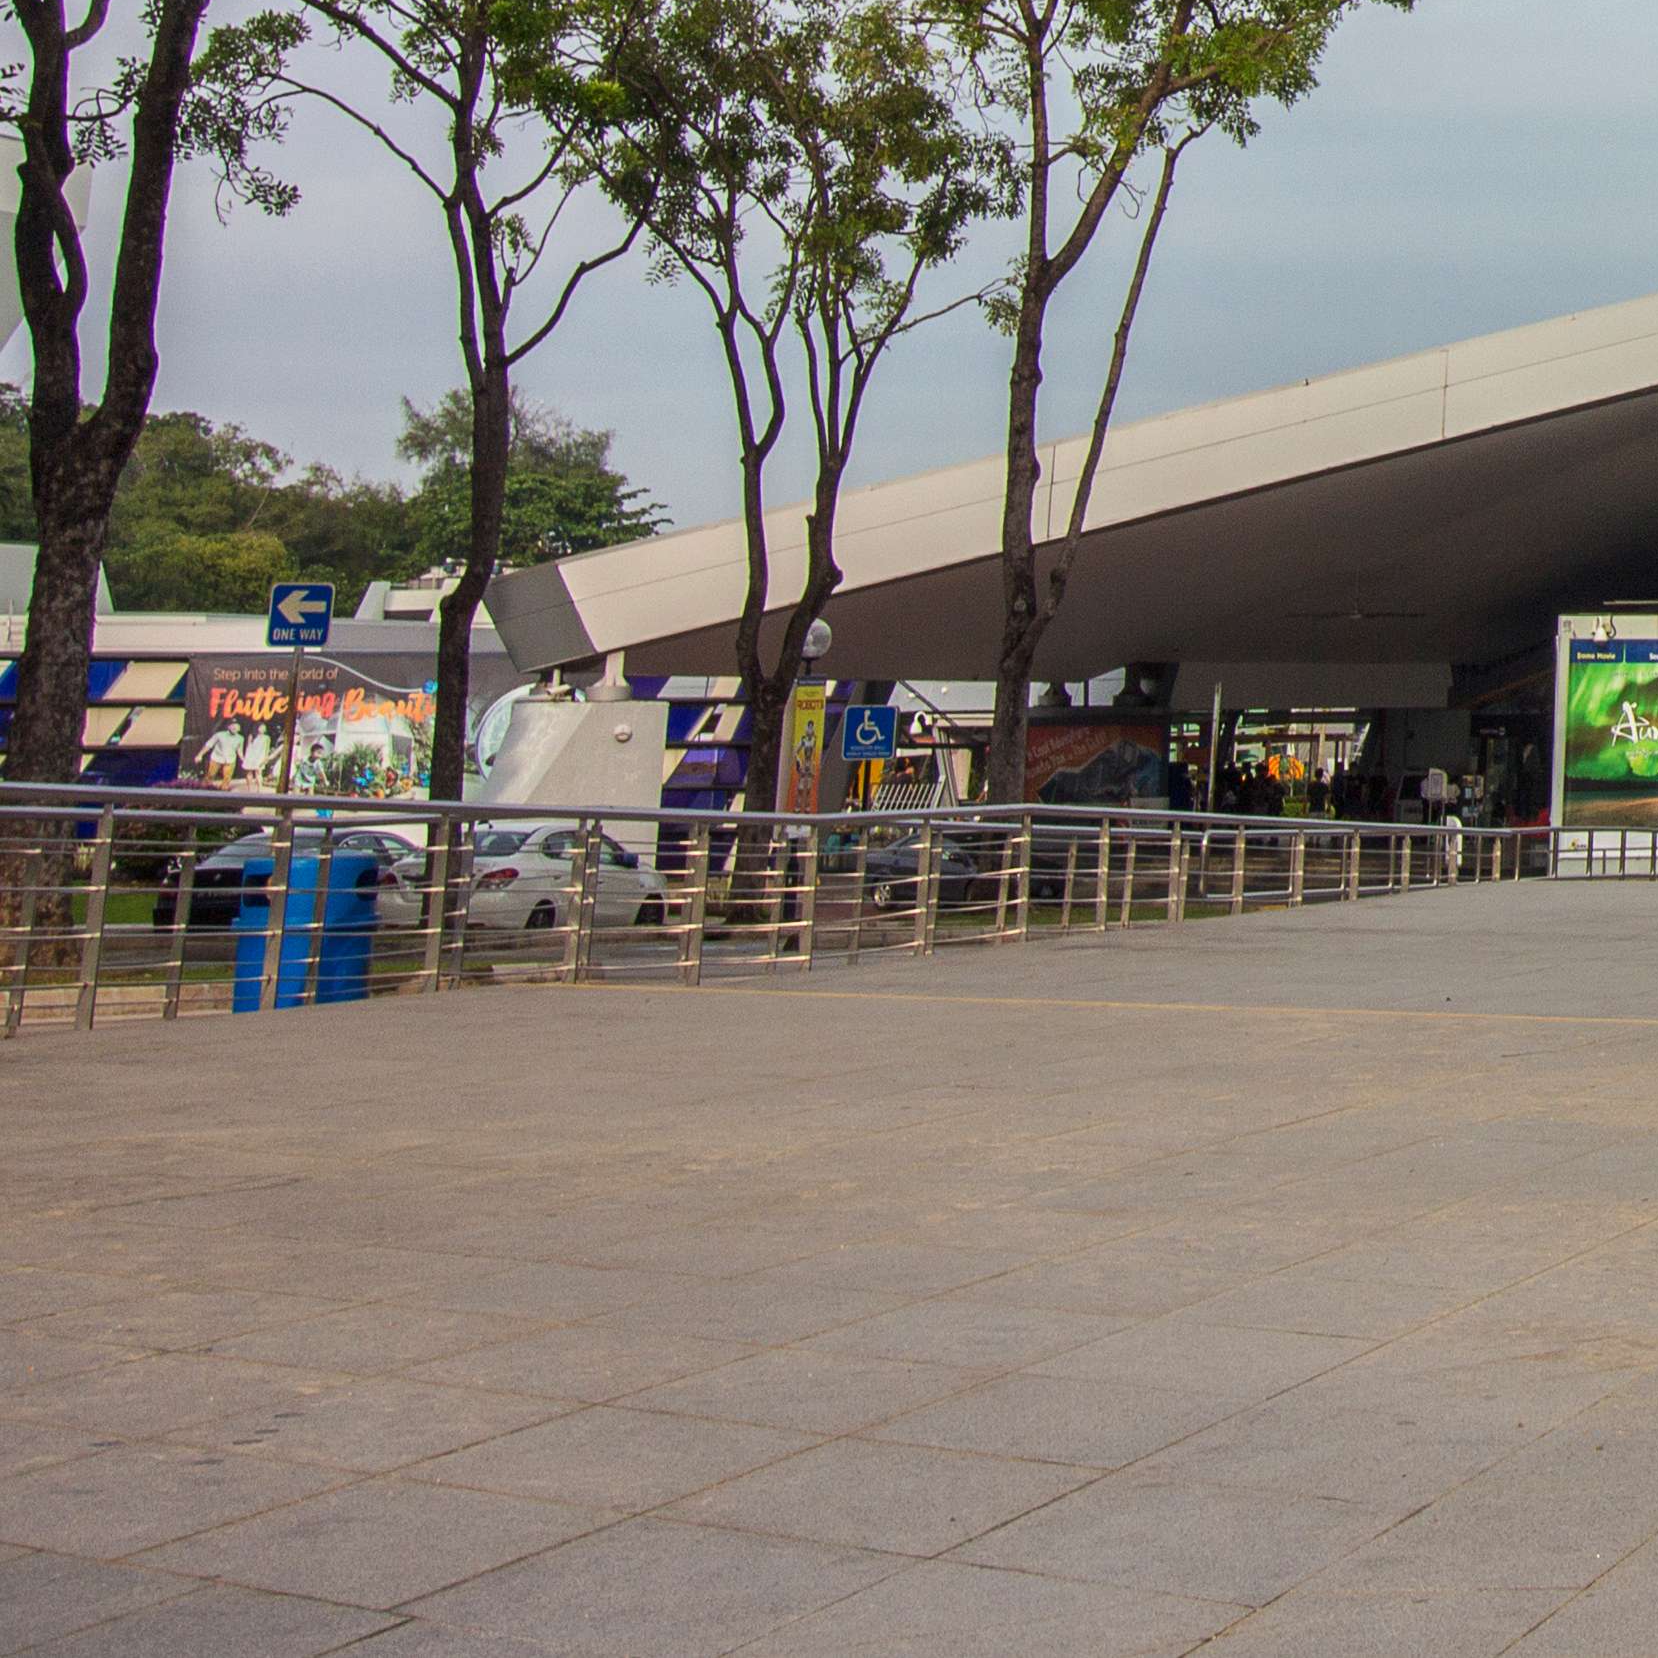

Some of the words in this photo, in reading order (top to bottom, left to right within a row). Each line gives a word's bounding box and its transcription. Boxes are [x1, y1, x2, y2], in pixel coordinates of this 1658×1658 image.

[273, 628, 295, 640] ONE
[299, 628, 323, 640] WAY
[213, 668, 240, 682] Step
[244, 668, 265, 681] into
[270, 668, 288, 681] the
[299, 668, 324, 680] orld
[326, 667, 338, 680] of
[209, 686, 336, 721] Flutteing
[344, 687, 436, 723] Beauti
